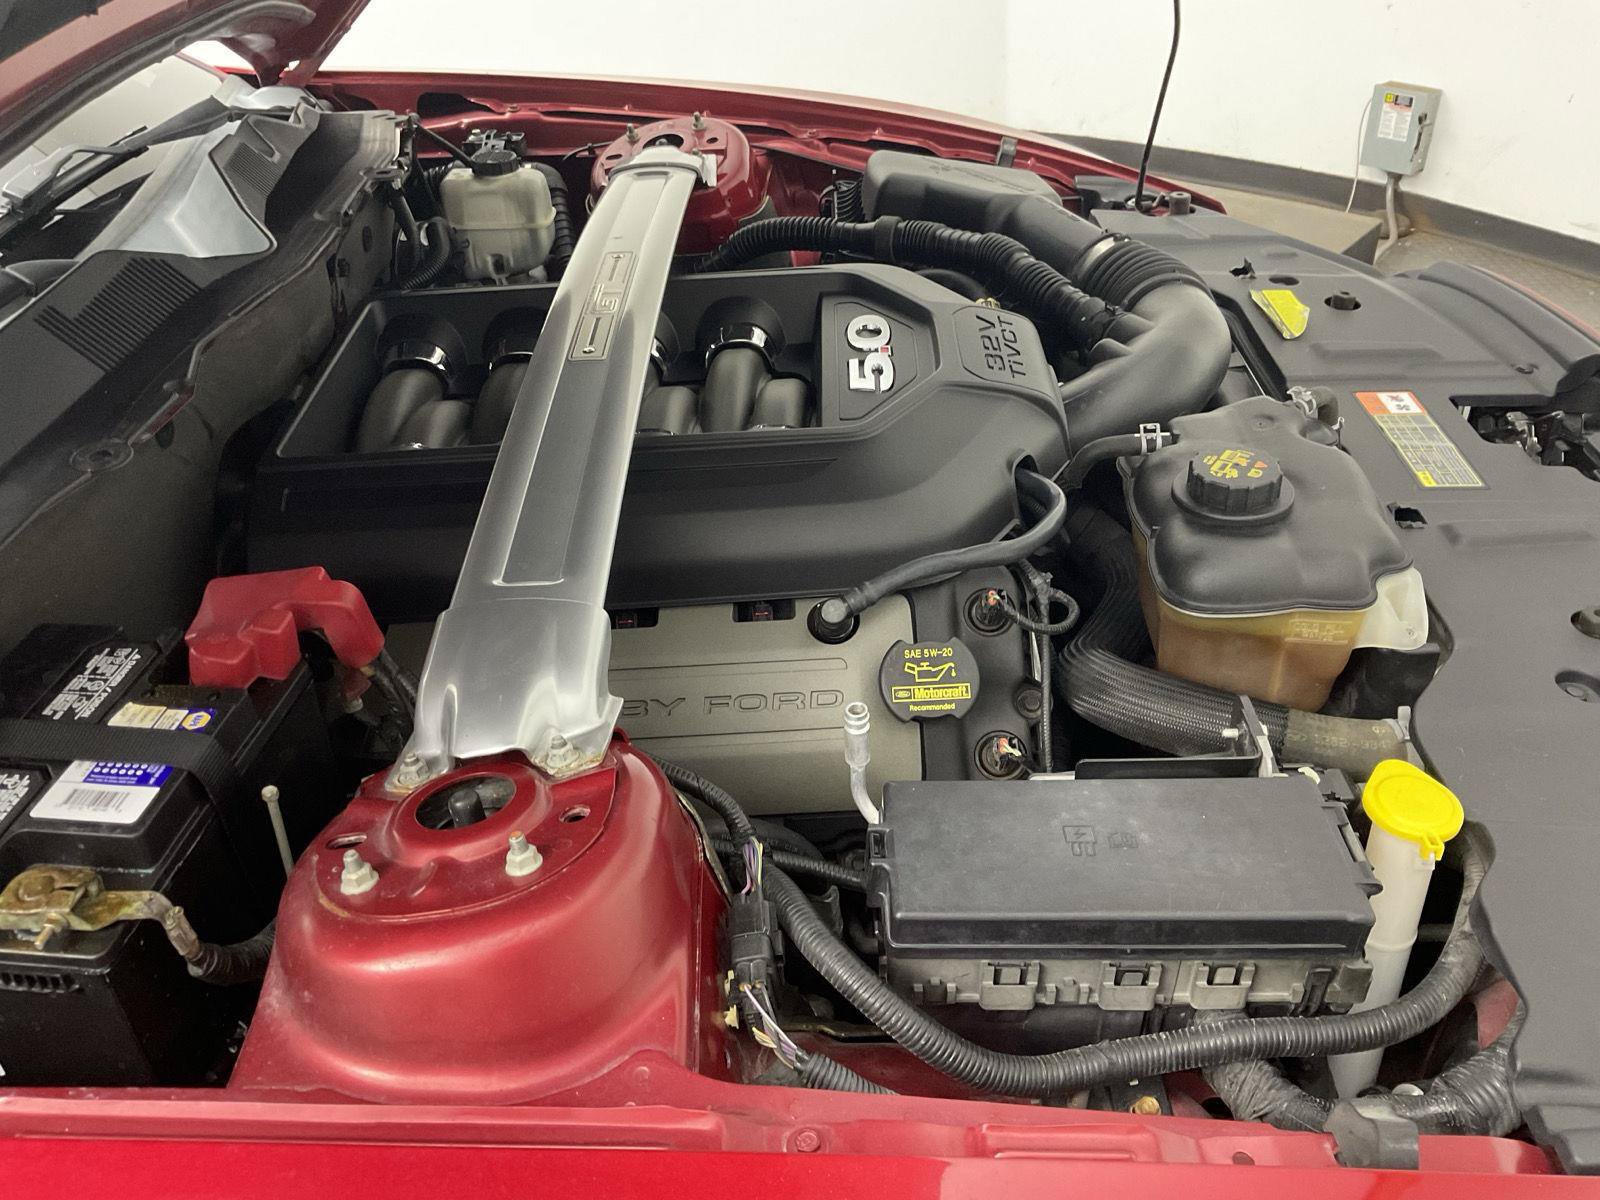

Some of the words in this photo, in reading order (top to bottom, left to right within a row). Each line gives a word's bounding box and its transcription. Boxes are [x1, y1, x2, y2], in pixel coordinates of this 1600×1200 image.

[846, 314, 895, 393] 5.0
[976, 315, 1005, 371] 32V
[904, 649, 921, 659] SAE
[923, 647, 953, 658] 5W-20
[914, 685, 968, 699] Motorcraft
[621, 697, 686, 717] BY
[702, 689, 845, 715] FORD
[909, 702, 956, 712] Recommended
